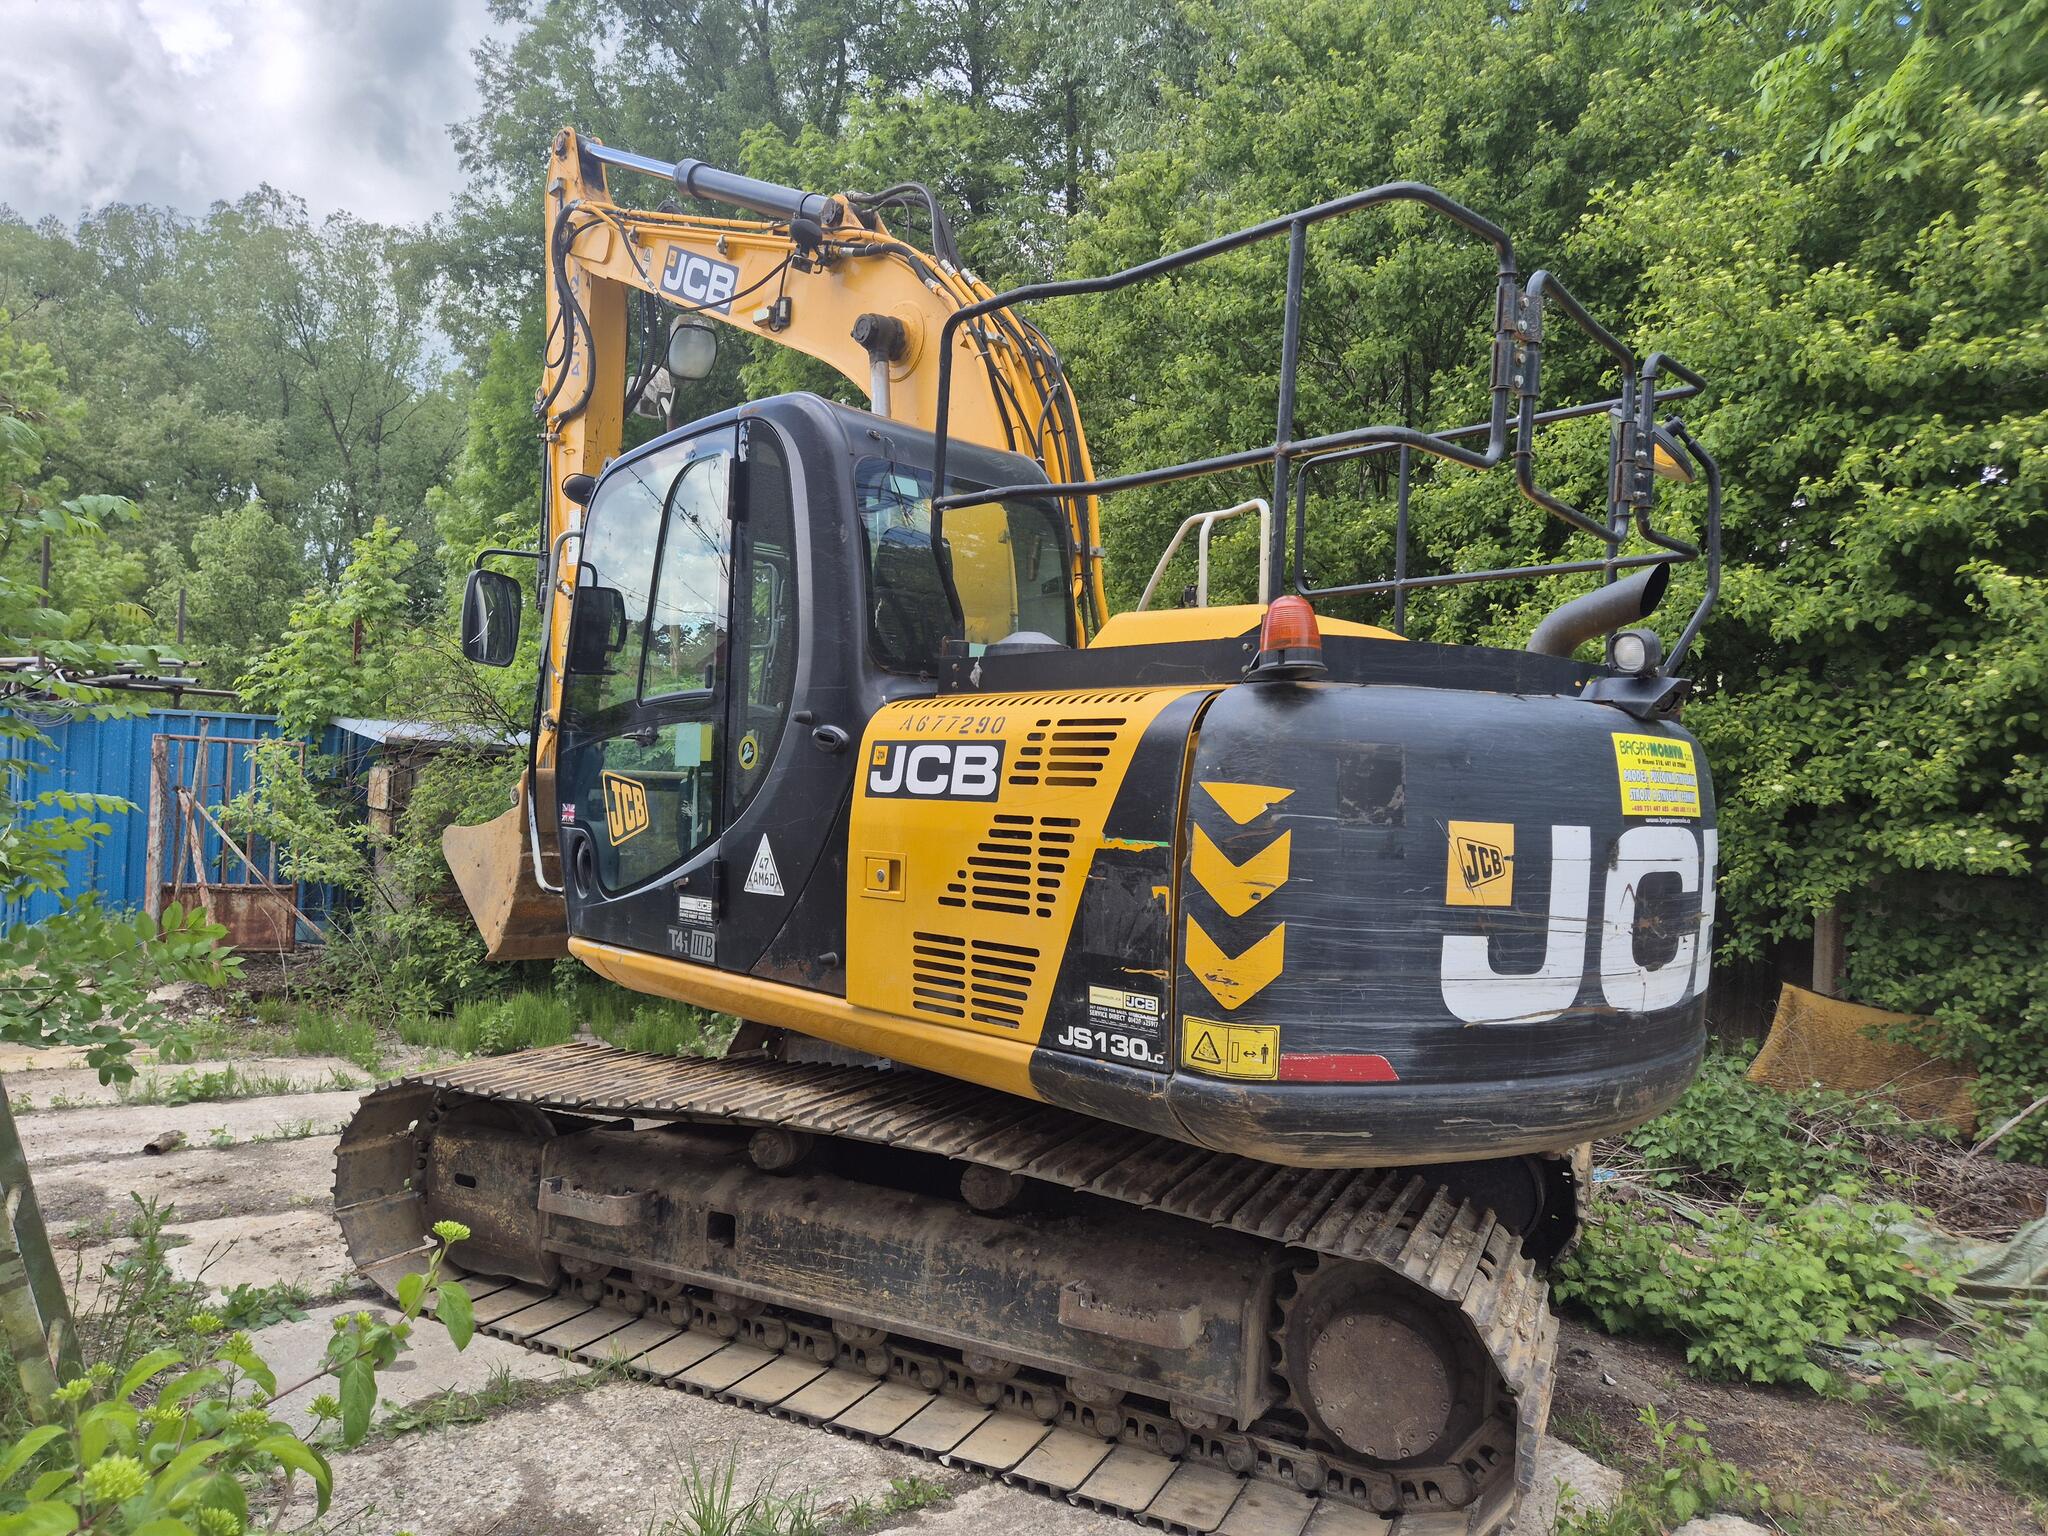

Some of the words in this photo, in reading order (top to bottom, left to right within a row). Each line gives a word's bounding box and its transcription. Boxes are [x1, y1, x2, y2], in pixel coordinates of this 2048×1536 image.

[663, 252, 735, 309] JCB
[899, 714, 1007, 735] A677290
[869, 744, 999, 796] JCB
[610, 779, 646, 838] JCB
[759, 857, 769, 871] 47
[1465, 842, 1502, 883] JCB
[668, 928, 689, 953] T4i
[1126, 995, 1156, 1012] JCB
[1109, 1013, 1126, 1022] DIRECT
